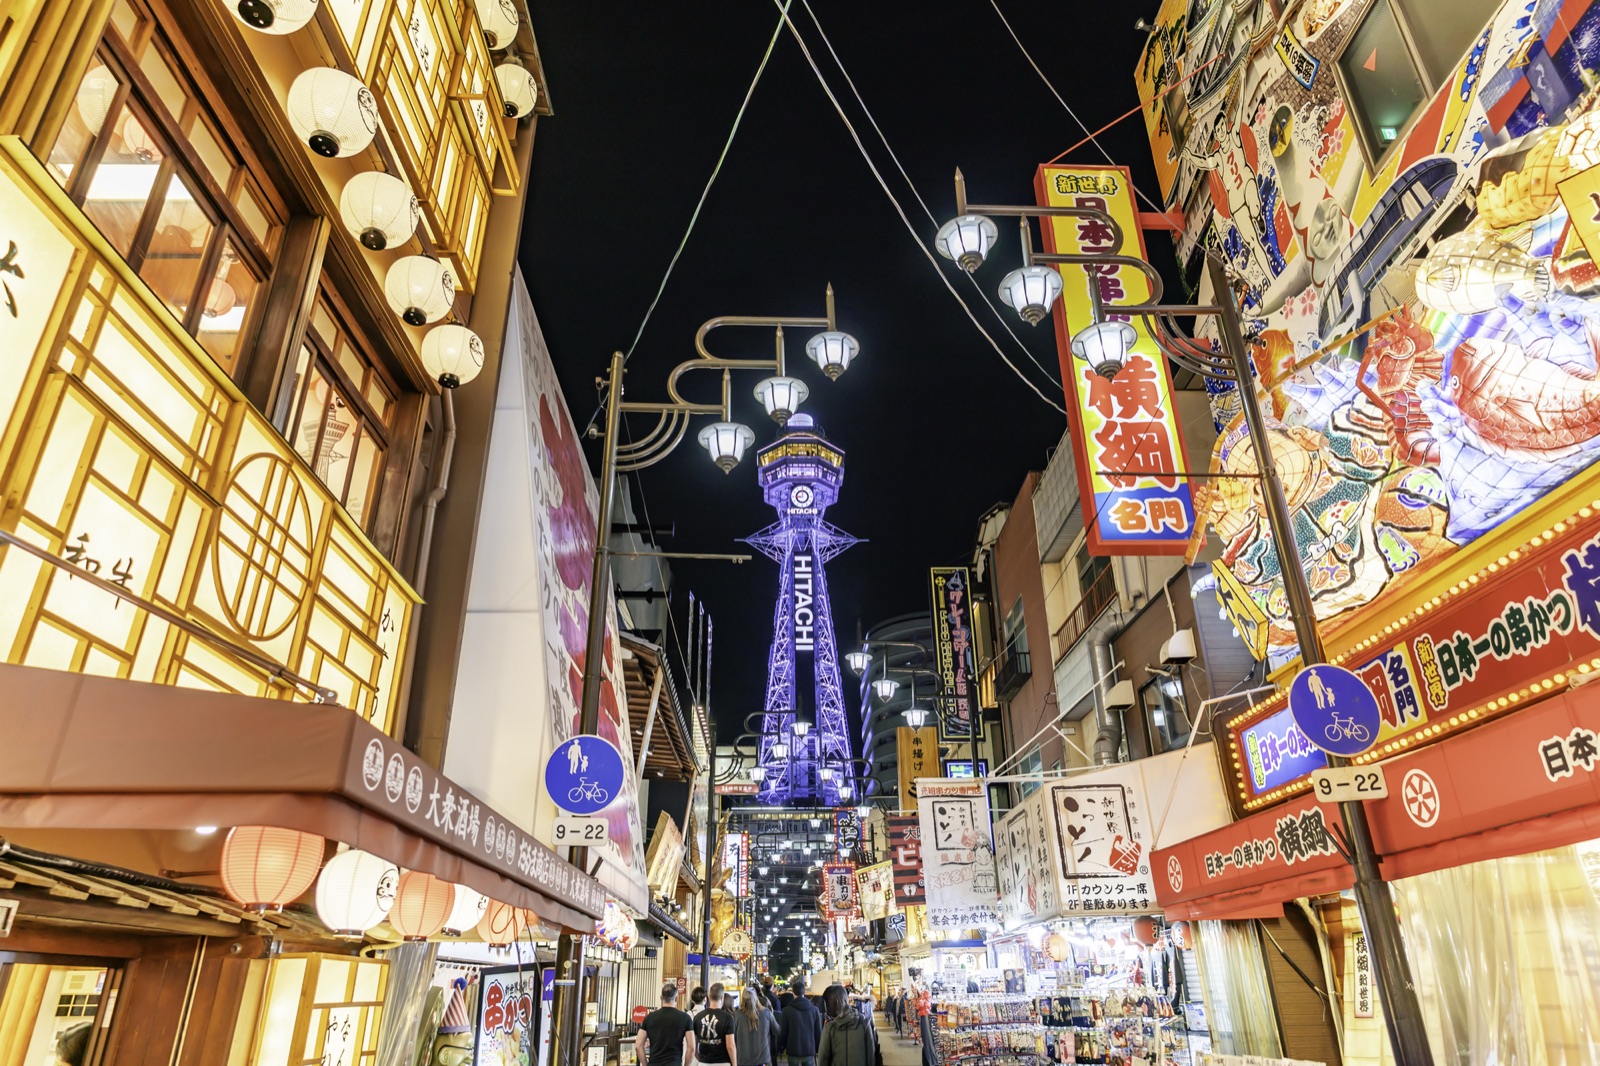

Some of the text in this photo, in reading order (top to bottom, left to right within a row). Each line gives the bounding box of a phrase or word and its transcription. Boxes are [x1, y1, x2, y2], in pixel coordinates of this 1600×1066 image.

[1057, 174, 1118, 195] 新世界
[1085, 357, 1178, 489] 横綱
[1110, 498, 1186, 532] 名門
[794, 555, 814, 650] HITACHI
[1436, 593, 1572, 687] 日本一の串かつ
[1388, 654, 1419, 724] 名門
[1416, 636, 1447, 707] 新世界
[912, 737, 924, 771] 串揚げ
[425, 777, 481, 848] 大衆酒場
[1101, 797, 1121, 834] 新世界
[1205, 808, 1330, 877] 日本一の串かつ 横綱
[836, 874, 849, 902] 串カツ
[1067, 882, 1148, 895] 1F カウンター席
[1068, 898, 1150, 911] 2F 座敷あります
[931, 911, 997, 926] 宴会予約受付中
[484, 980, 532, 1037] 串かつ
